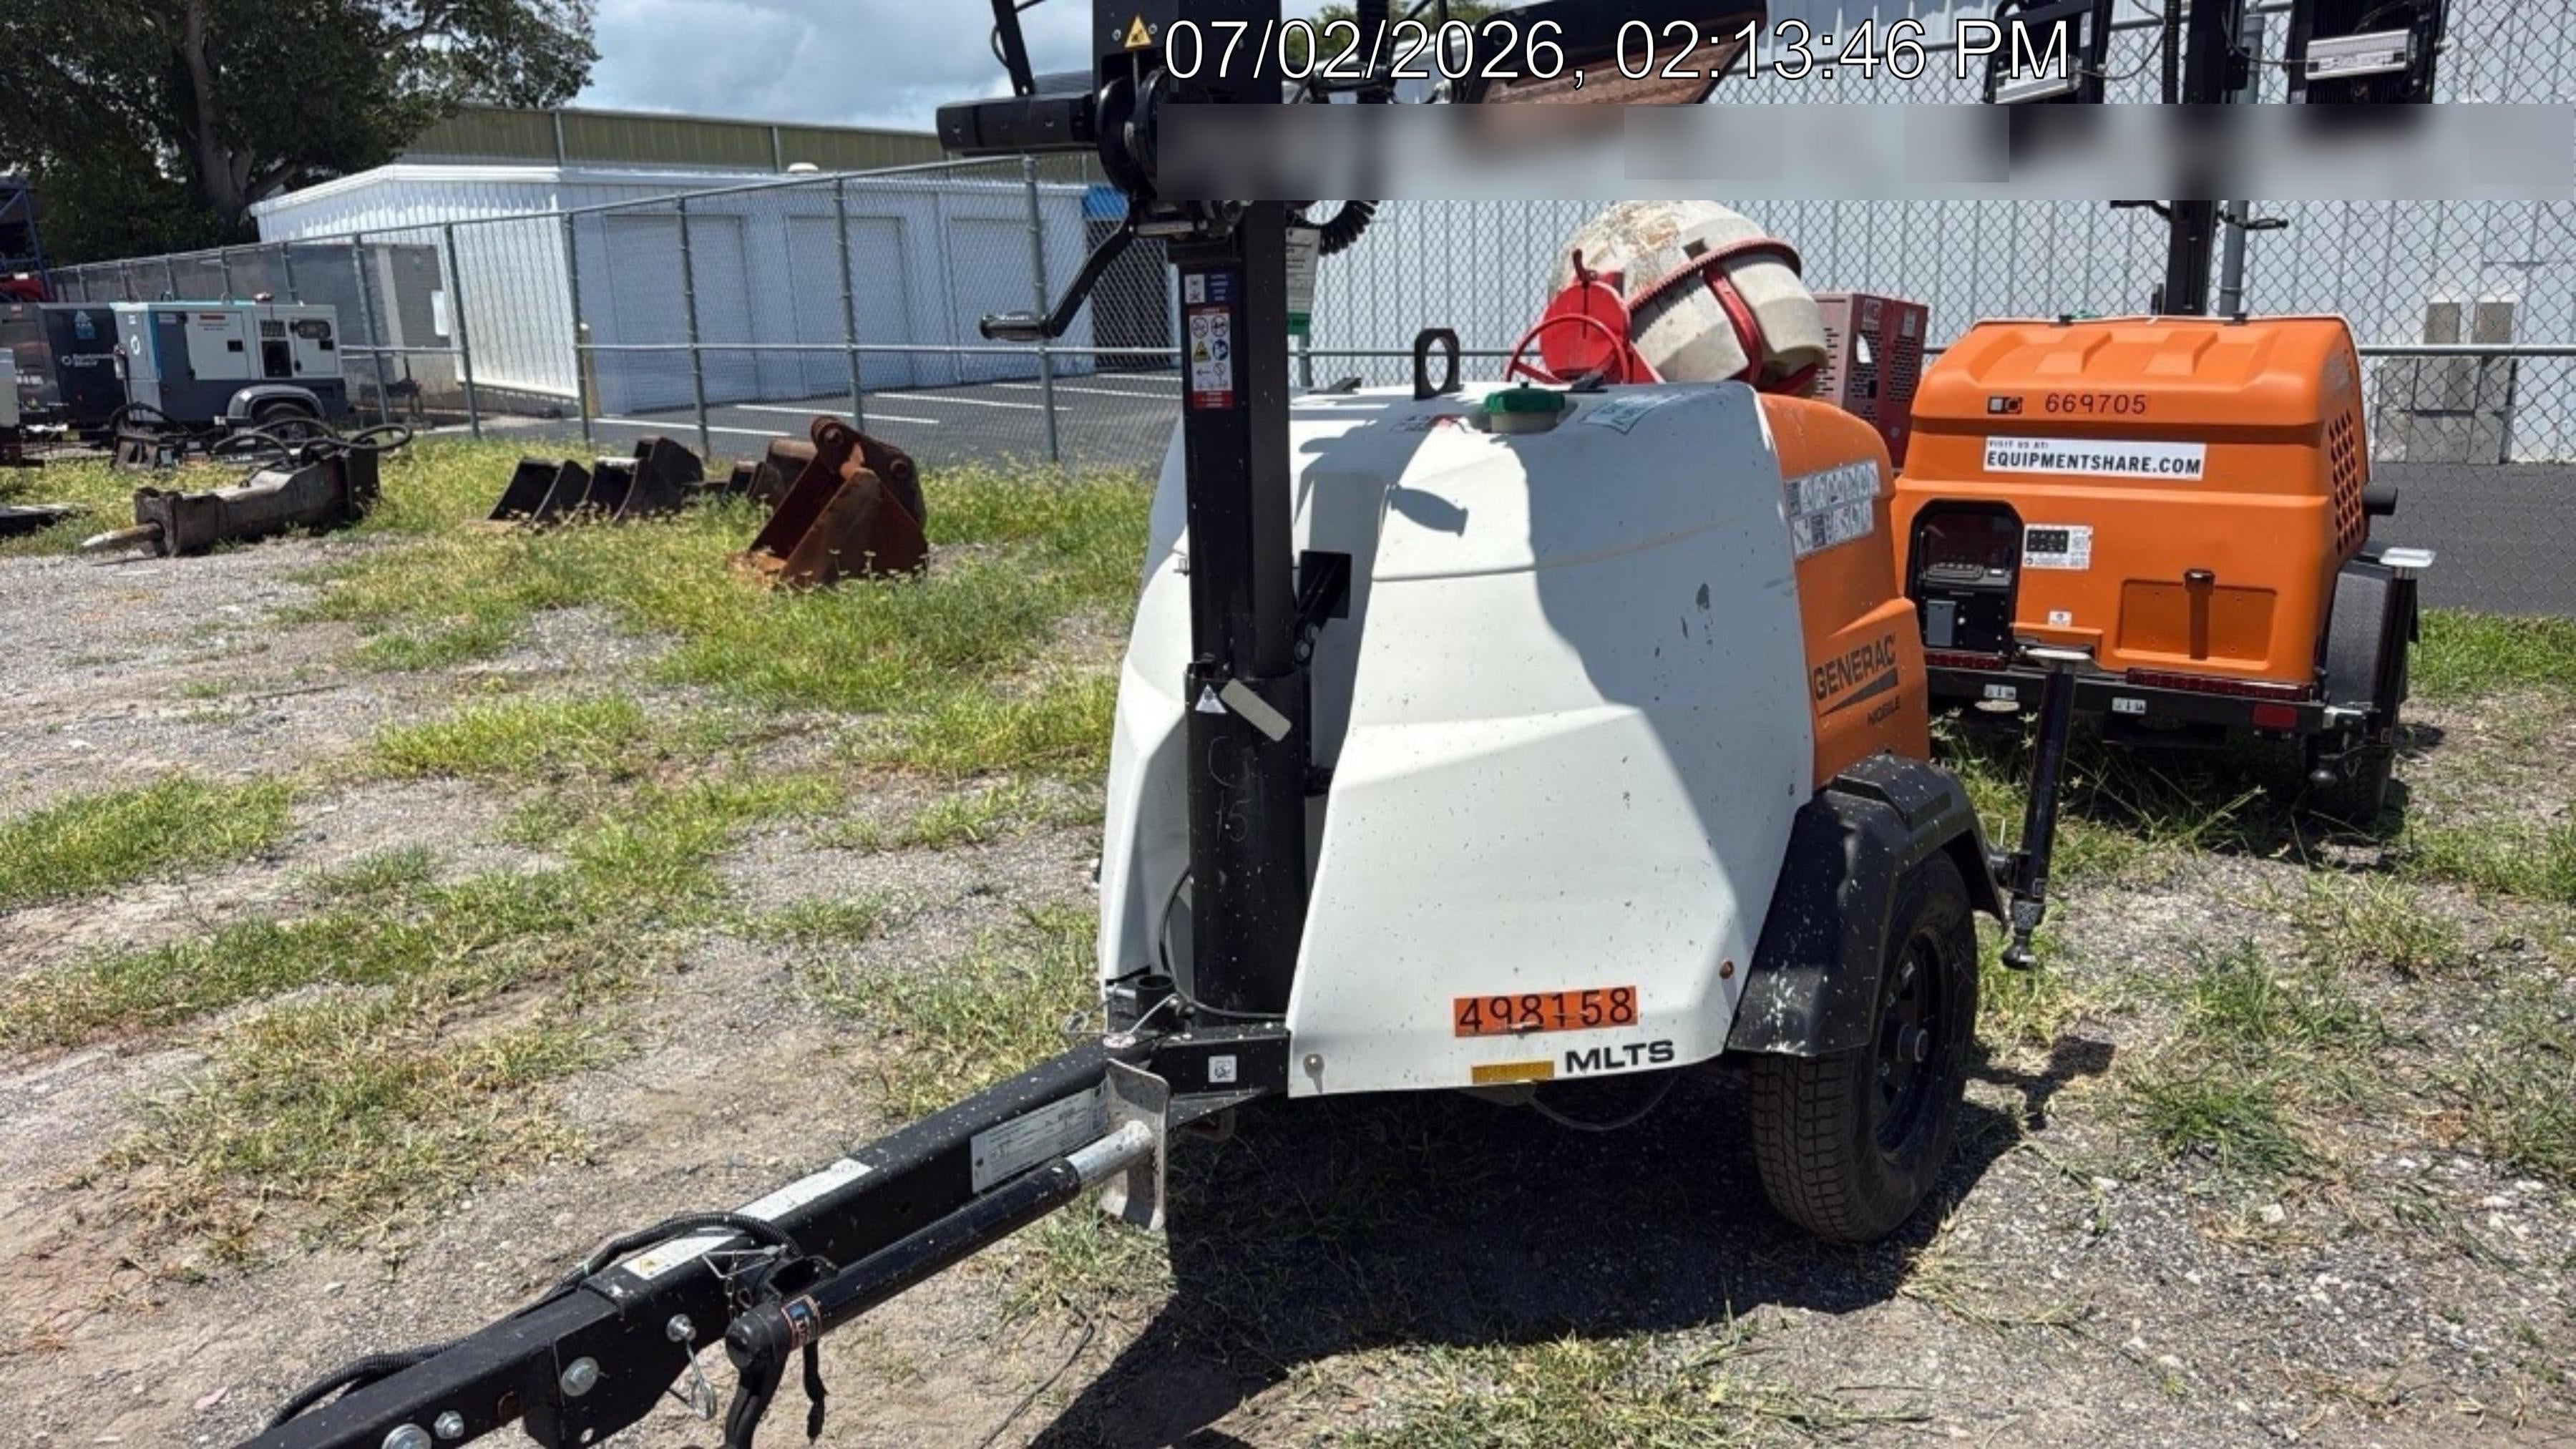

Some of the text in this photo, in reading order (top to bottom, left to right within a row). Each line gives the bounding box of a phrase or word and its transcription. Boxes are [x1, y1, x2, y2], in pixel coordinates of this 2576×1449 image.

[2044, 393, 2146, 415] 669705
[1986, 450, 2202, 474] EQUIPMENTSHARE.COM
[1813, 632, 1897, 701] GENERAC
[1459, 987, 1633, 1033] 498158
[1565, 1039, 1675, 1073] MLTS
